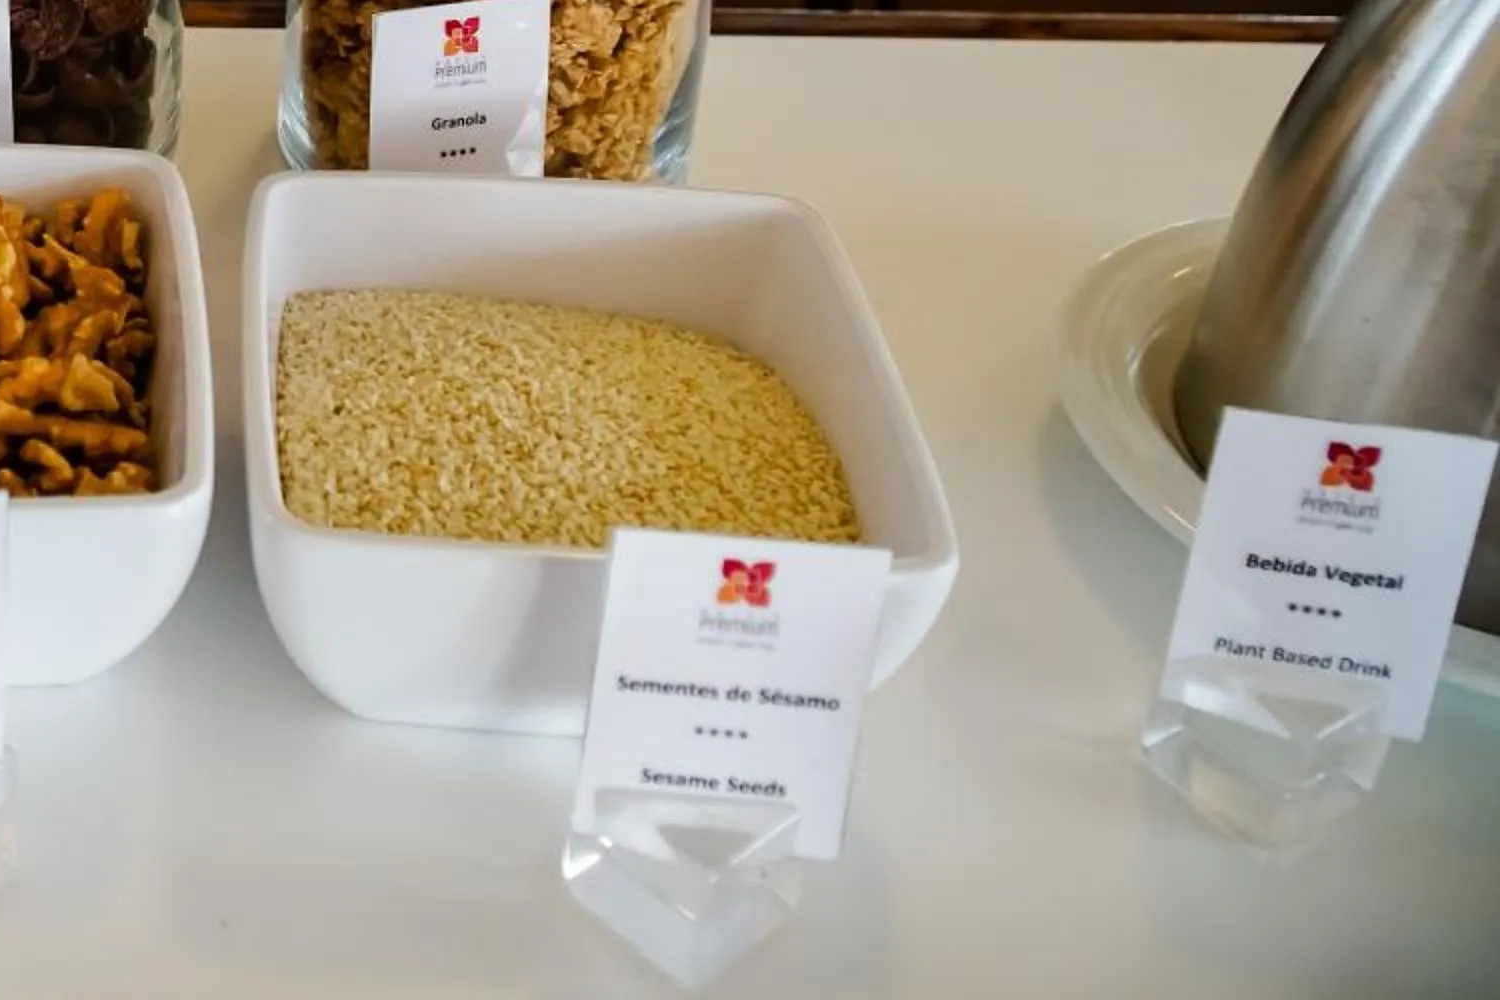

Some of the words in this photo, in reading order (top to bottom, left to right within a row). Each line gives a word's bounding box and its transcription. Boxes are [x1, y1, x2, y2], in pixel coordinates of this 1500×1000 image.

[431, 112, 488, 131] Granola
[1245, 553, 1318, 578] Bebida
[1324, 564, 1405, 590] Vegetal
[1214, 636, 1266, 660] Plant
[1271, 647, 1333, 670] Based
[1338, 657, 1392, 680] Drink
[616, 674, 720, 700] Sementes
[725, 686, 752, 703] de
[757, 687, 841, 712] Sésamo
[639, 767, 720, 792] Sesame
[726, 776, 787, 799] Seeds
